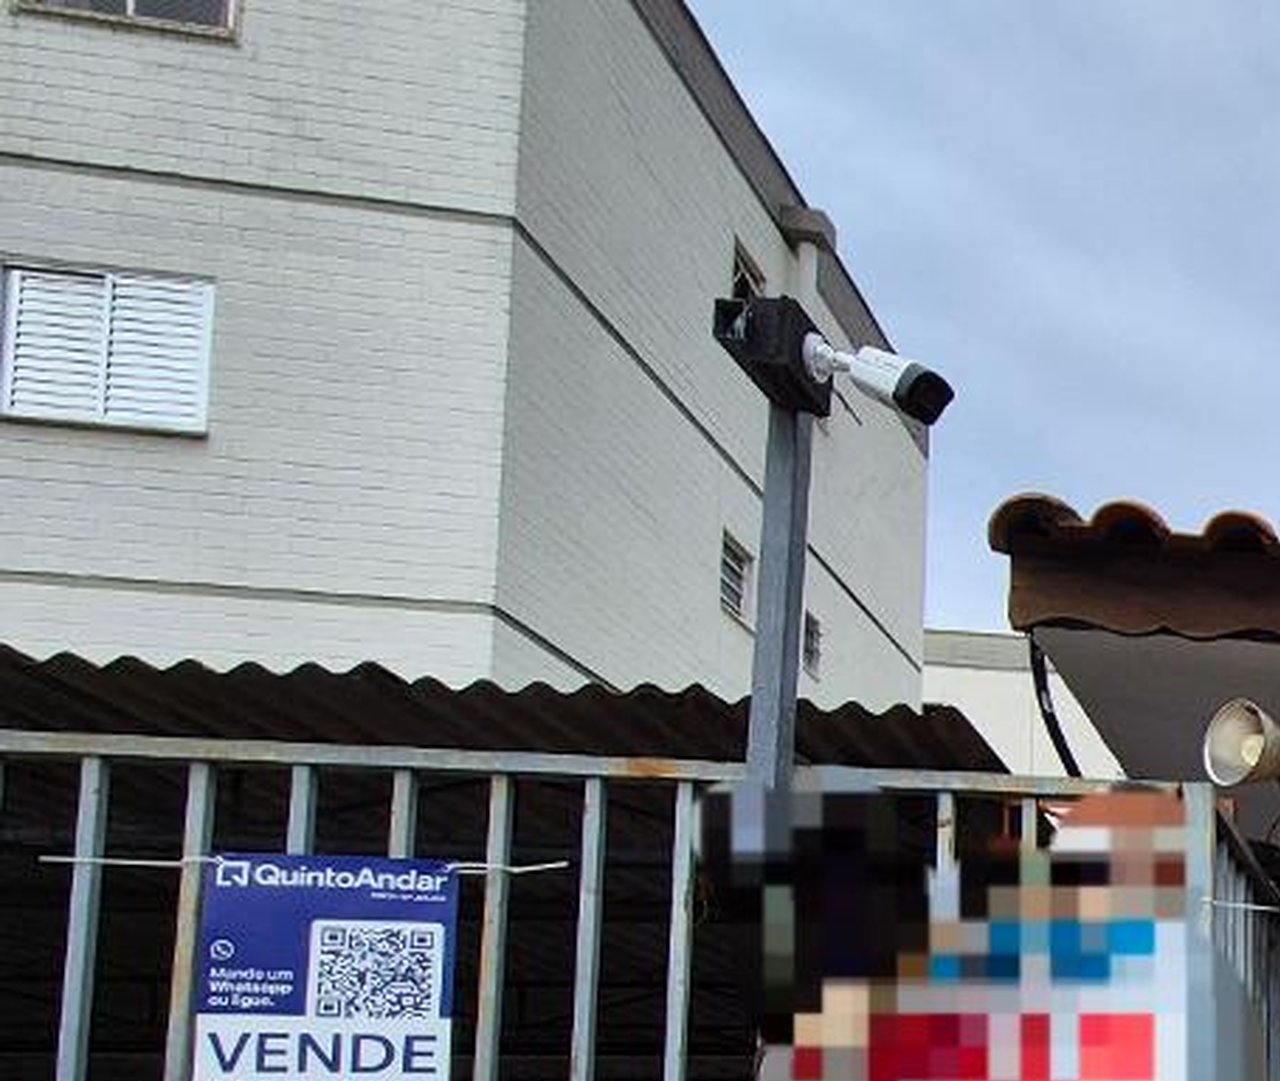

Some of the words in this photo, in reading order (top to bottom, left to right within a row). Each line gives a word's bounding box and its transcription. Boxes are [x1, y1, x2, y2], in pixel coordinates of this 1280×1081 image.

[254, 863, 449, 891] QuintoAndar
[266, 970, 294, 981] um
[207, 996, 229, 1006] ou
[207, 1032, 438, 1074] VENDE
